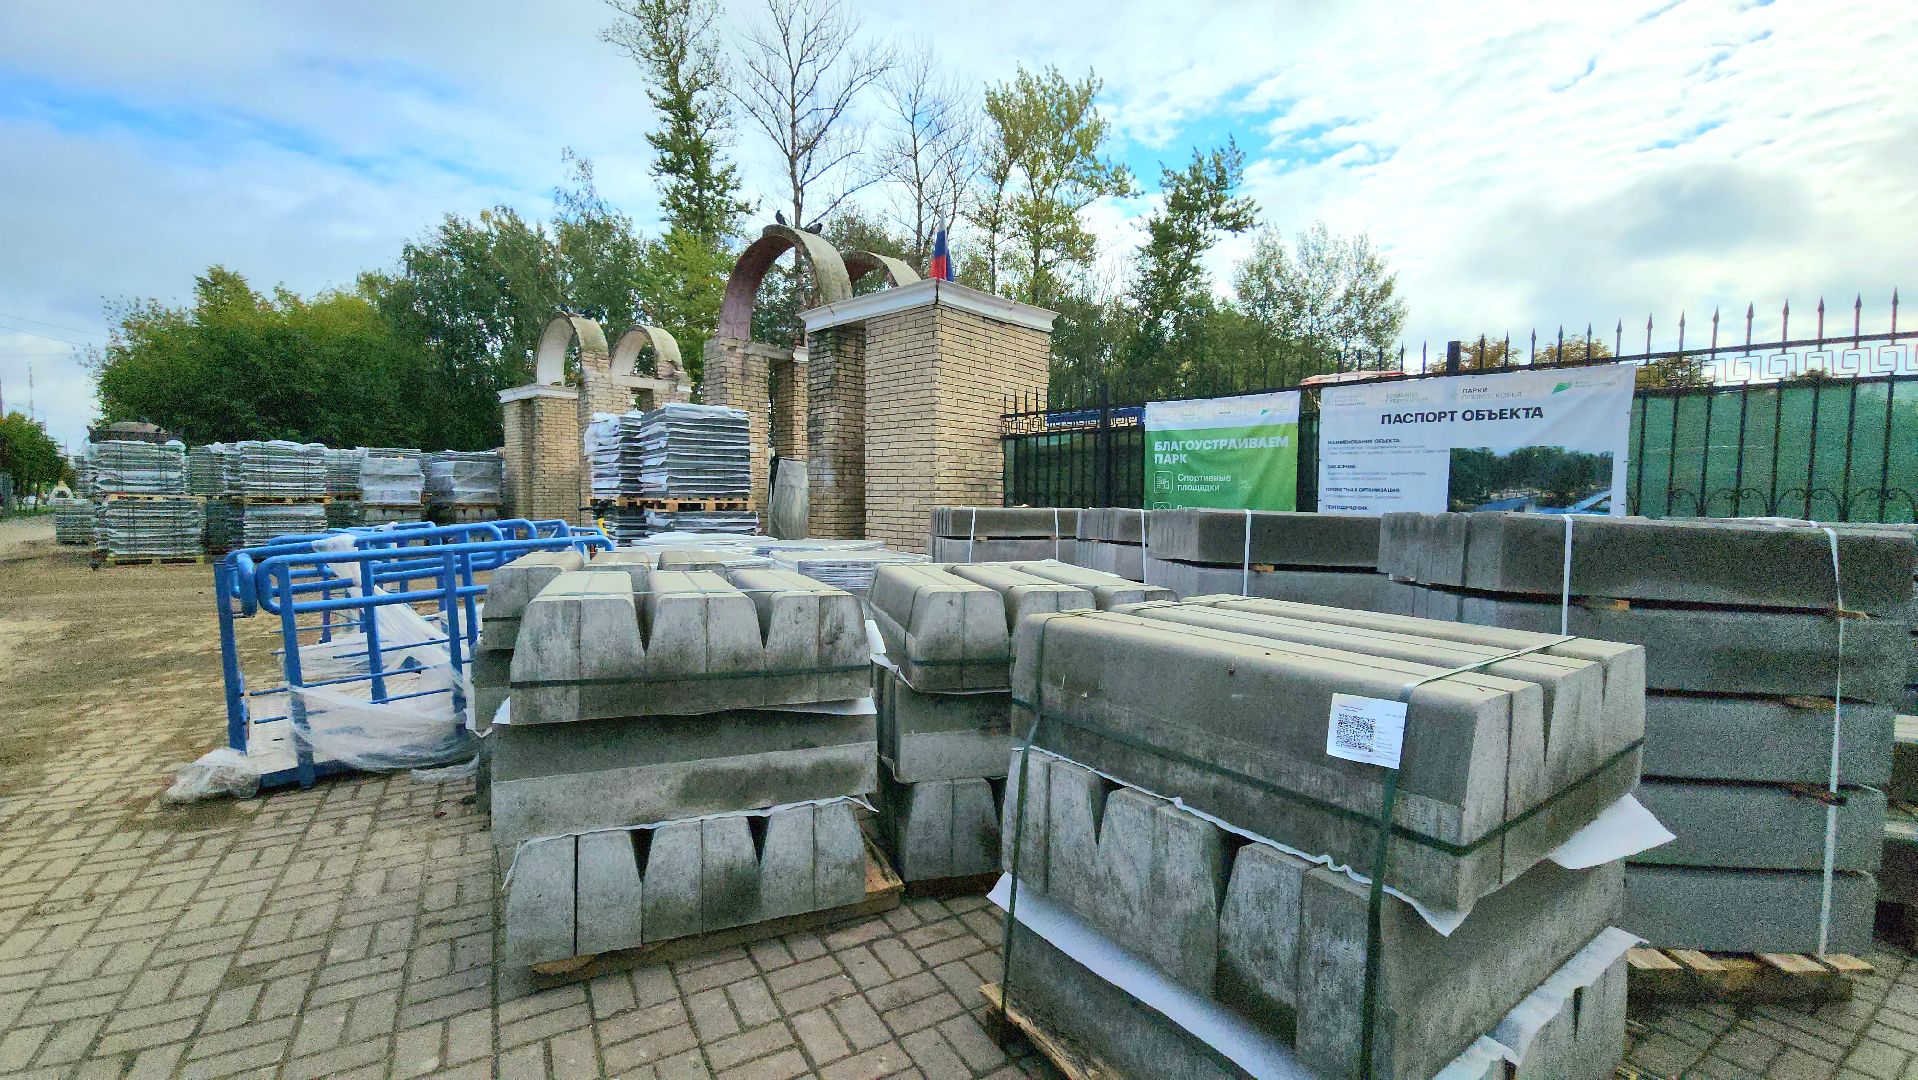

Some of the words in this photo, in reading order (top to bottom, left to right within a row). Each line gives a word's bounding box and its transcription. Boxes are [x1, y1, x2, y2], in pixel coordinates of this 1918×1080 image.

[1380, 410, 1458, 426] ПАСПОРТ
[1461, 406, 1544, 422] ОБЪЕКТА
[1154, 435, 1289, 452] БЛАГОУСТРАИВАЕМ
[1154, 453, 1188, 465] ПАРК
[1177, 473, 1232, 483] Спортивные
[1177, 484, 1220, 492] площадки
